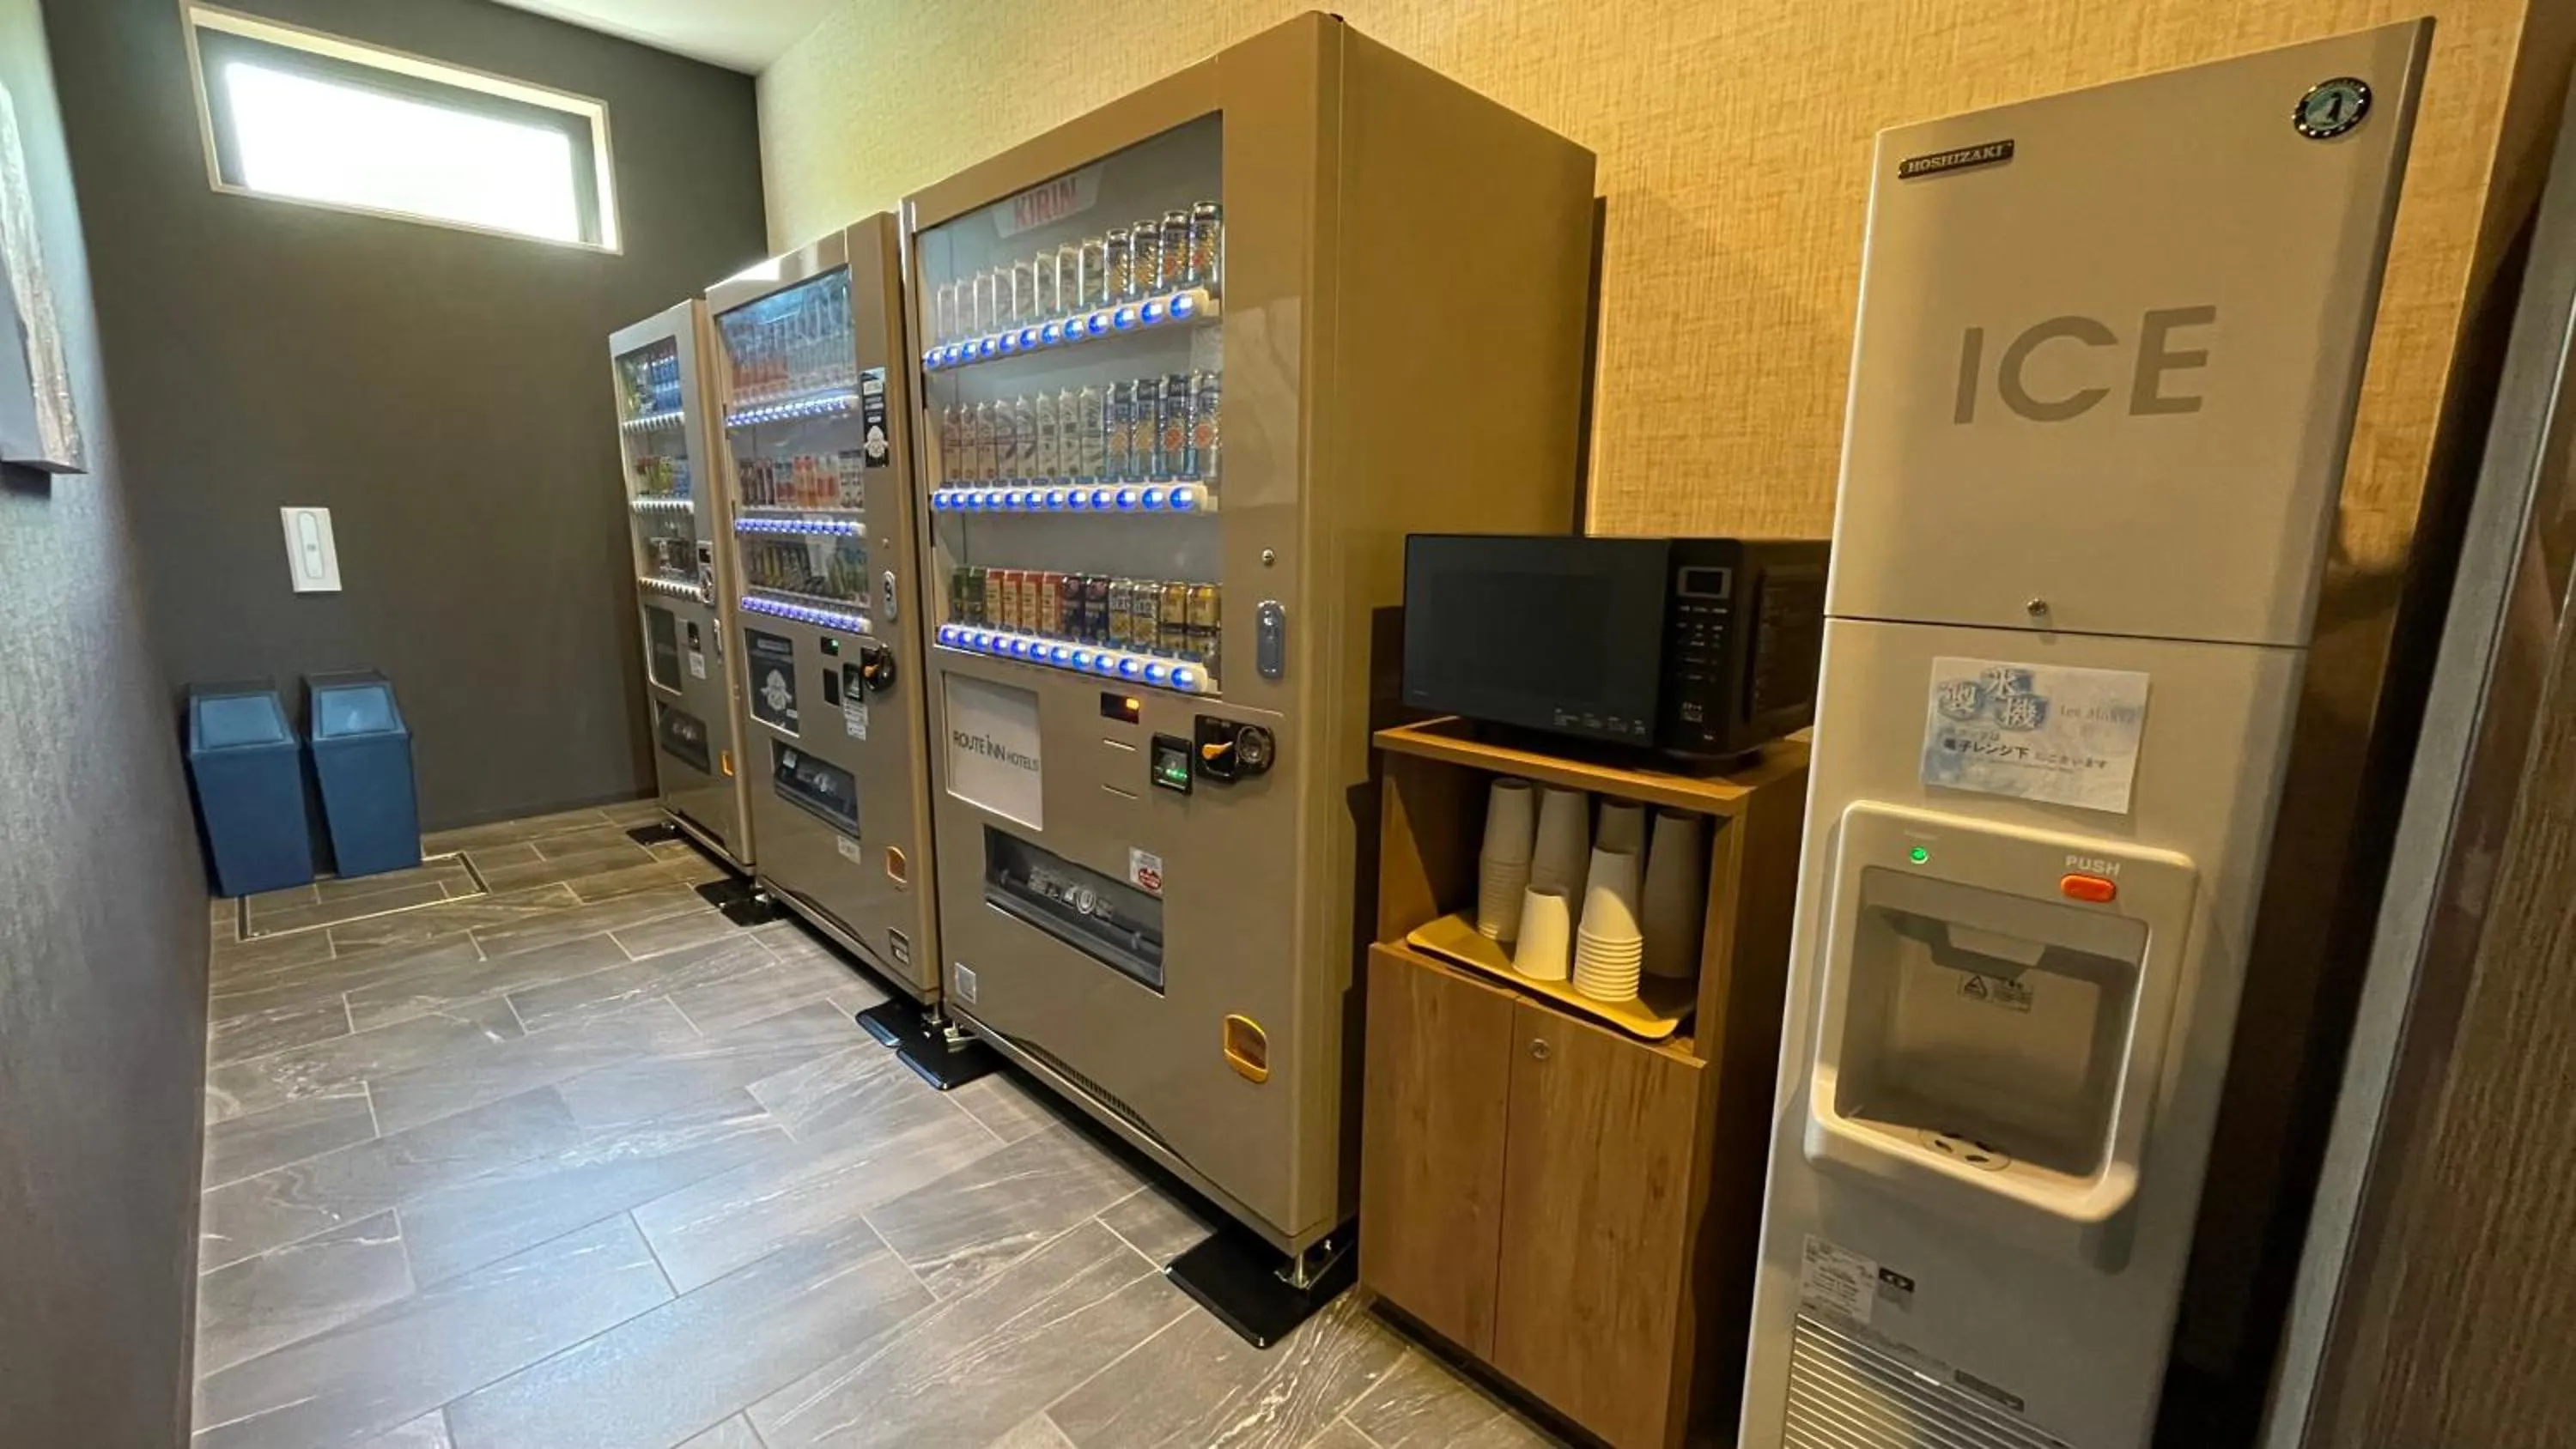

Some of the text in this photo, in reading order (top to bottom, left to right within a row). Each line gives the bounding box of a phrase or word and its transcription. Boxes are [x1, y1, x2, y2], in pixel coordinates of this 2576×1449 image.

[1907, 145, 2003, 173] HOSHIZAKI
[1014, 174, 1078, 227] KIRIN
[1953, 305, 2216, 425] ICE
[952, 730, 985, 755] ROUTE
[2066, 854, 2121, 876] PUSH
